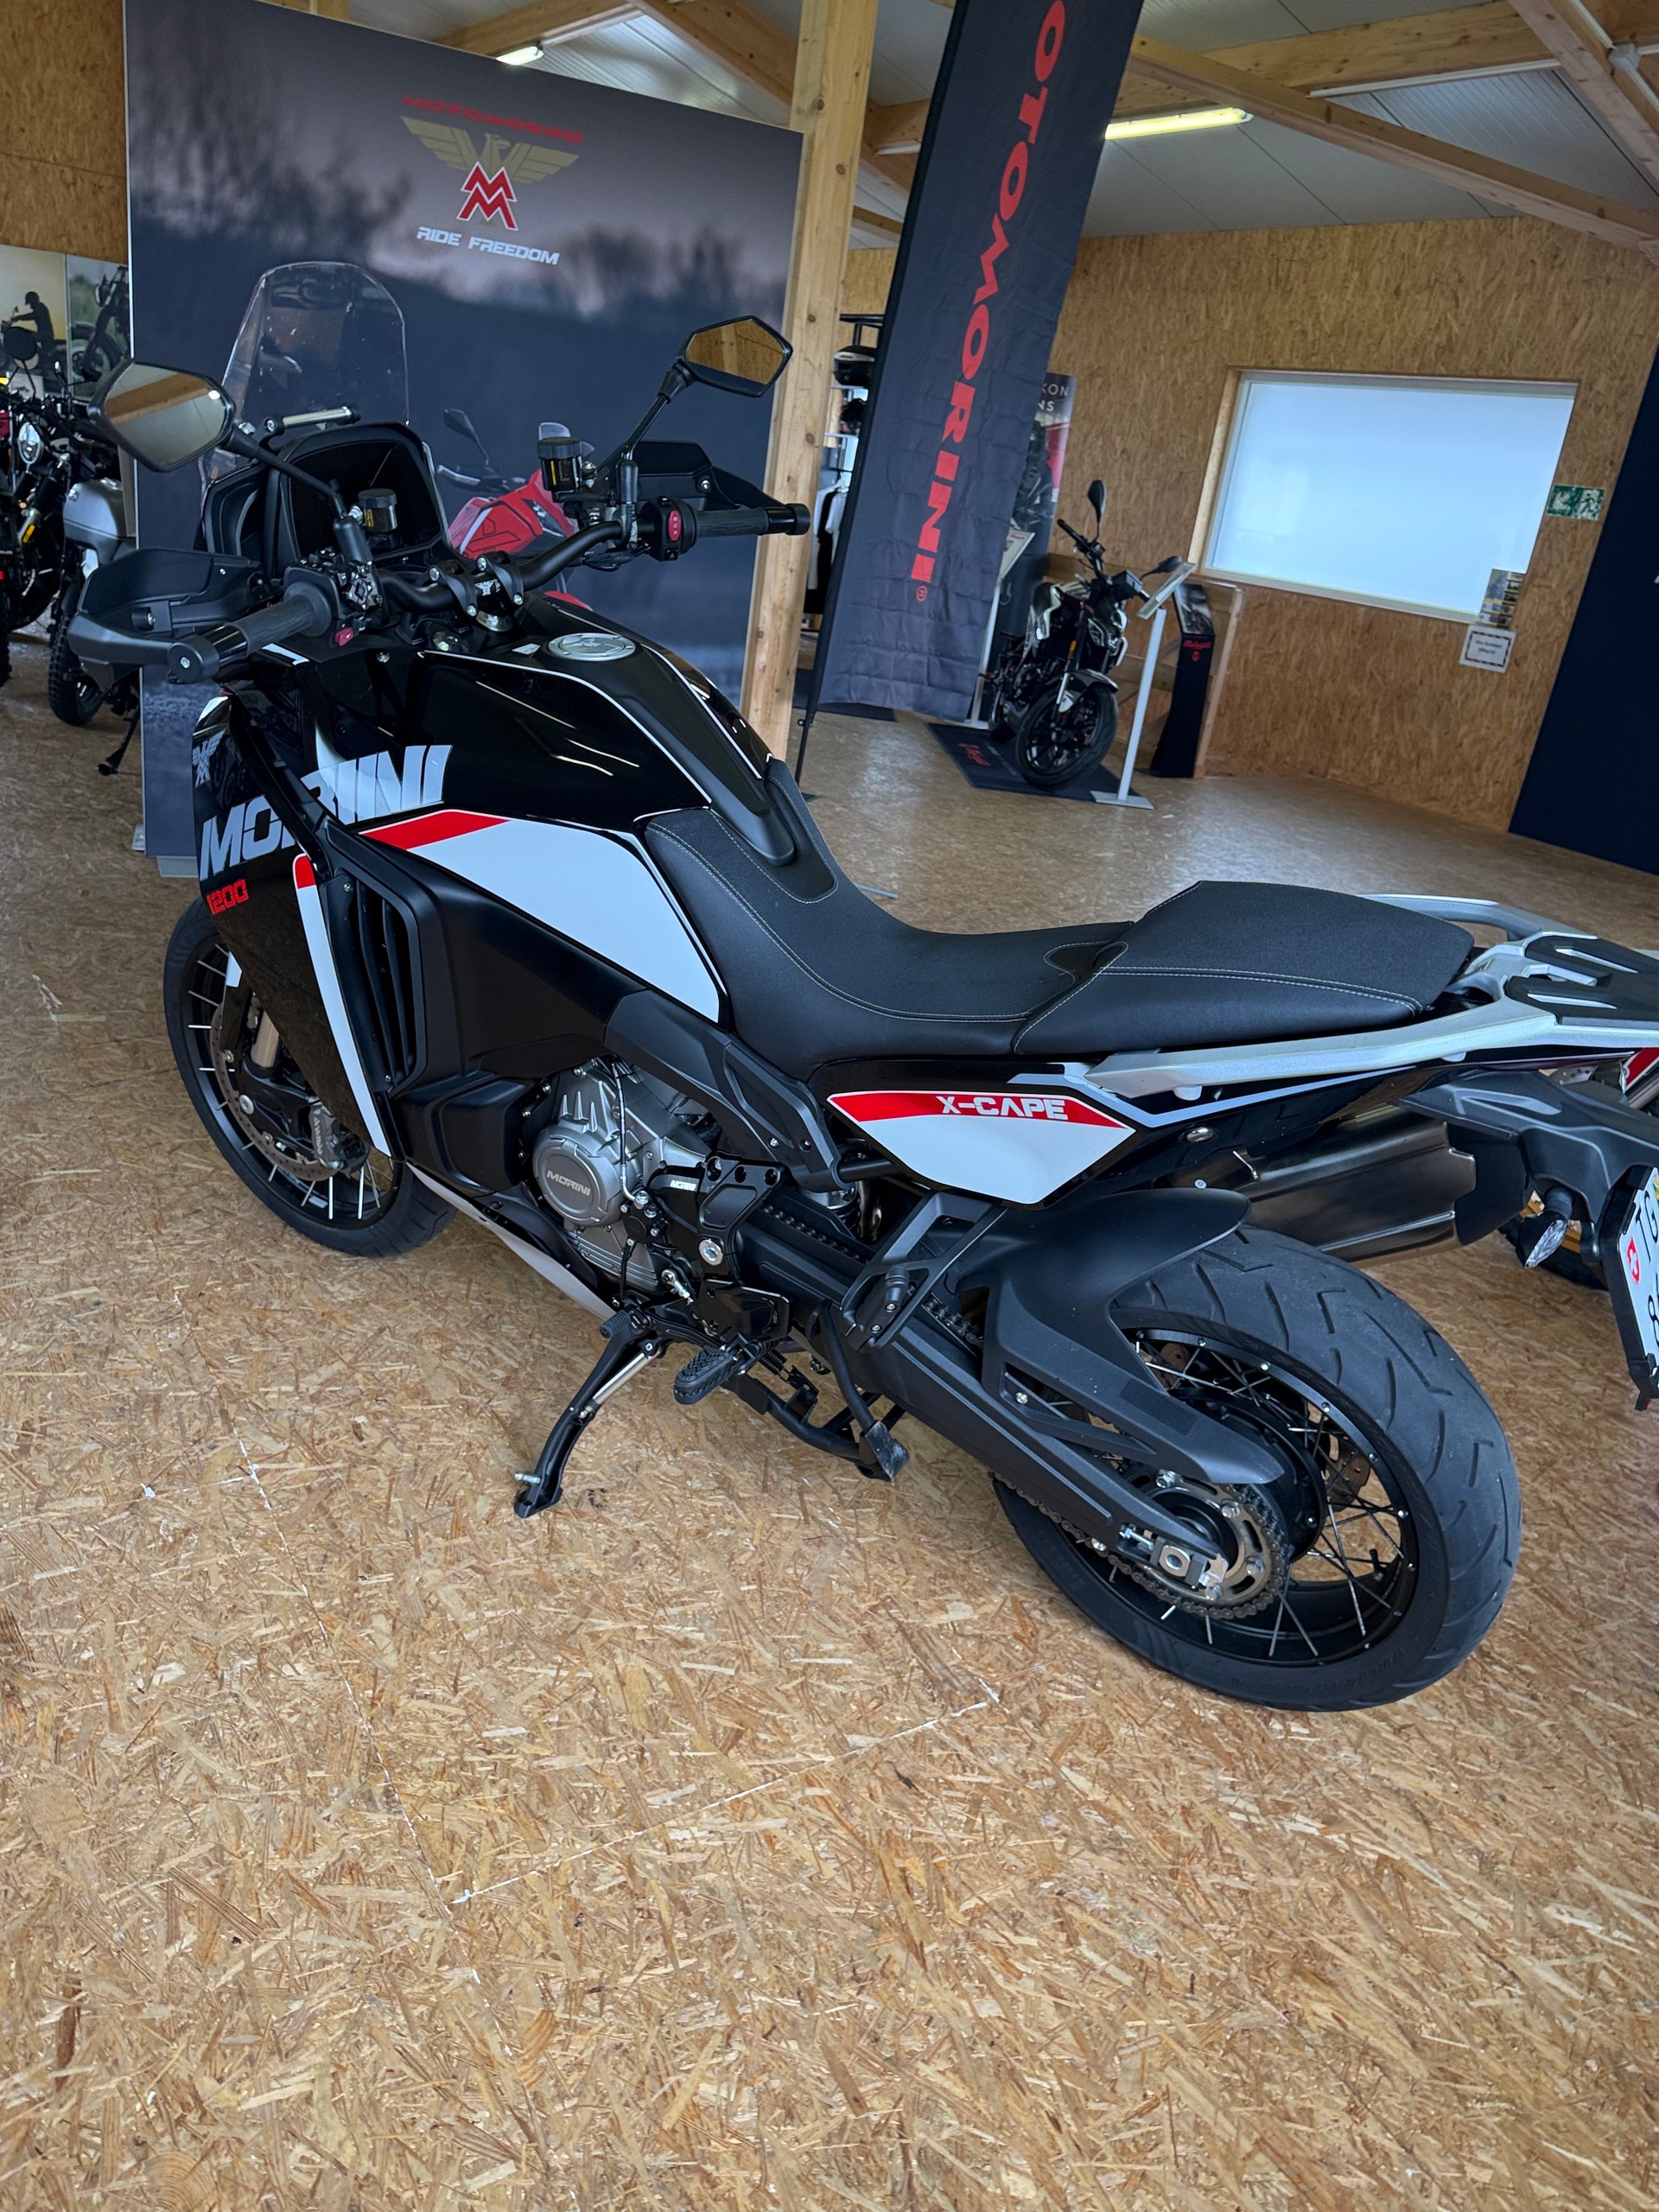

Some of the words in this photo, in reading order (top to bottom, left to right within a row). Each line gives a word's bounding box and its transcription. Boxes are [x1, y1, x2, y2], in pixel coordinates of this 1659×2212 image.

[416, 226, 461, 246] RIDE
[467, 236, 560, 265] FREEDOM
[207, 878, 250, 915] 1200
[936, 1096, 1069, 1121] X-CAPE
[546, 1169, 591, 1197] MORINI
